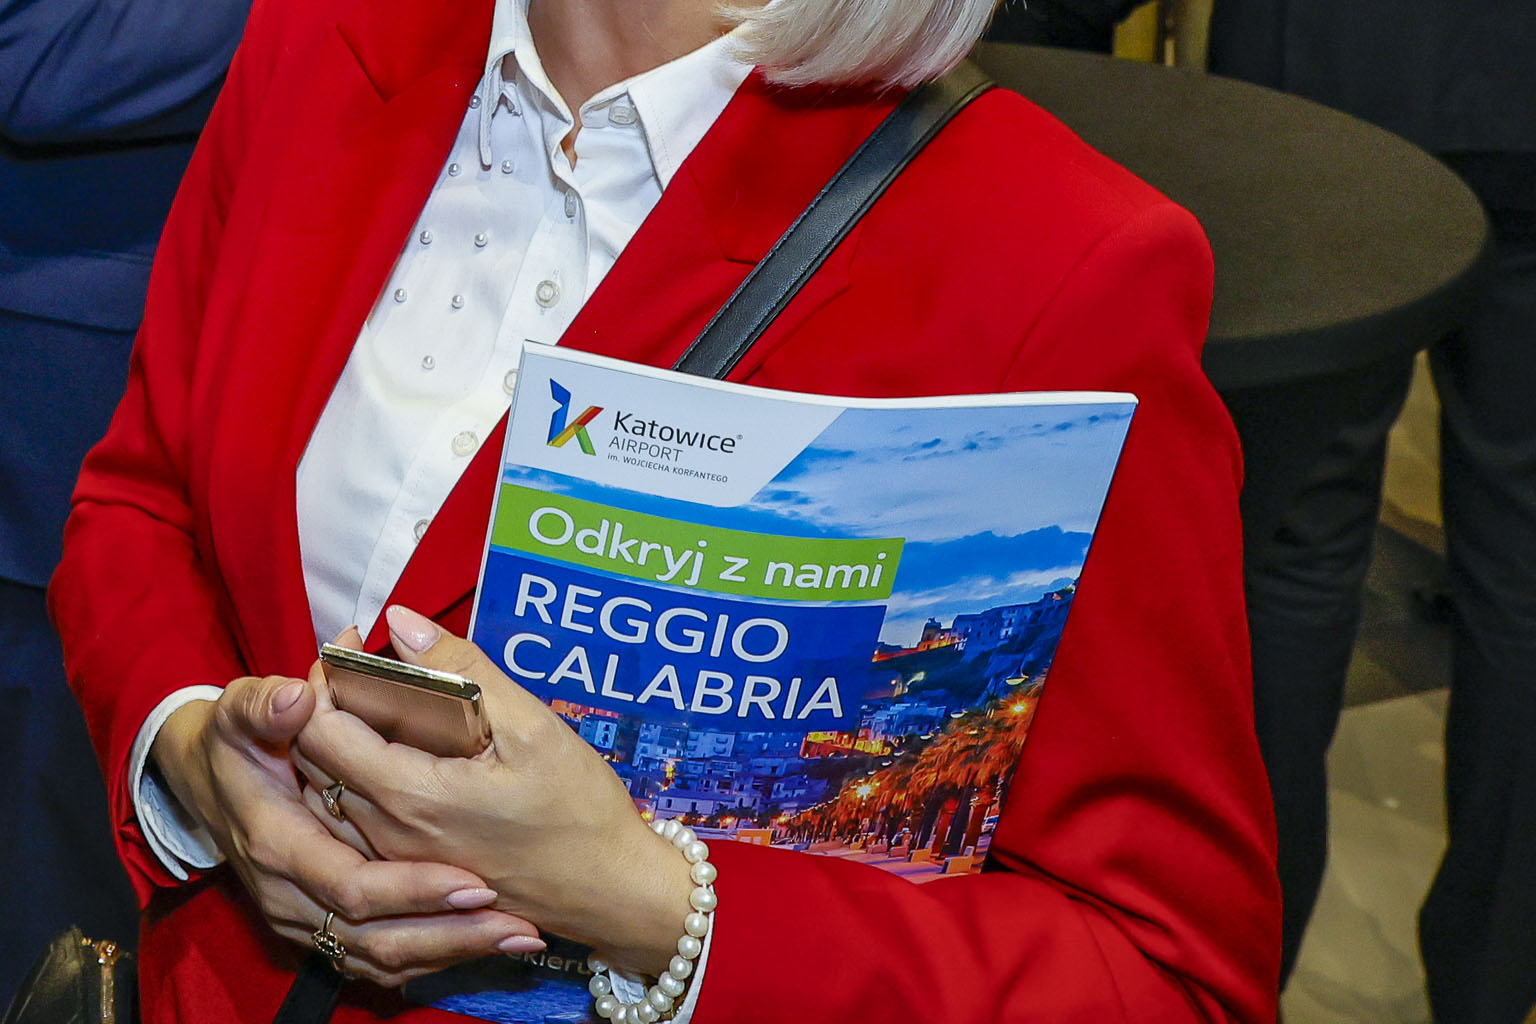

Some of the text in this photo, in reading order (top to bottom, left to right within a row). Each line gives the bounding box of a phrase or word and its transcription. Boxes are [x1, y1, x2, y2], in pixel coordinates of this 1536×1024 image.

[607, 452, 729, 484] im. WOJCIECHA KORFANTEGO
[608, 435, 684, 463] AIRPORT
[527, 506, 888, 589] Odkryj z nami
[513, 572, 790, 664] REGGIO
[502, 632, 844, 721] CALABRIA
